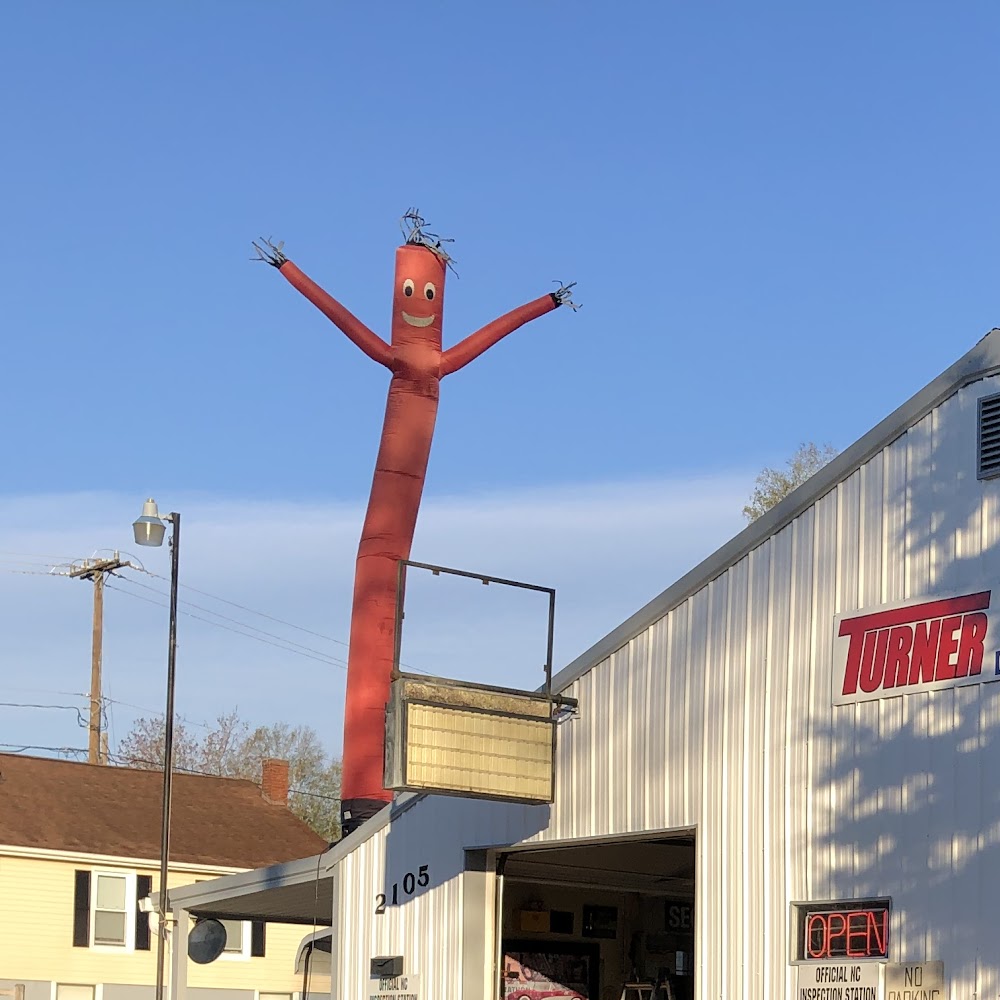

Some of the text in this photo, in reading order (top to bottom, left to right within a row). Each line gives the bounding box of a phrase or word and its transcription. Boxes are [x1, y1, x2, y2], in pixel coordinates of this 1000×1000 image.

[838, 590, 992, 696] TURNER
[374, 863, 430, 915] 2105
[807, 908, 888, 958] OPEN
[378, 977, 408, 992] OFFICIAL NC
[815, 965, 862, 984] OFFICIAL NC
[904, 966, 923, 988] NO
